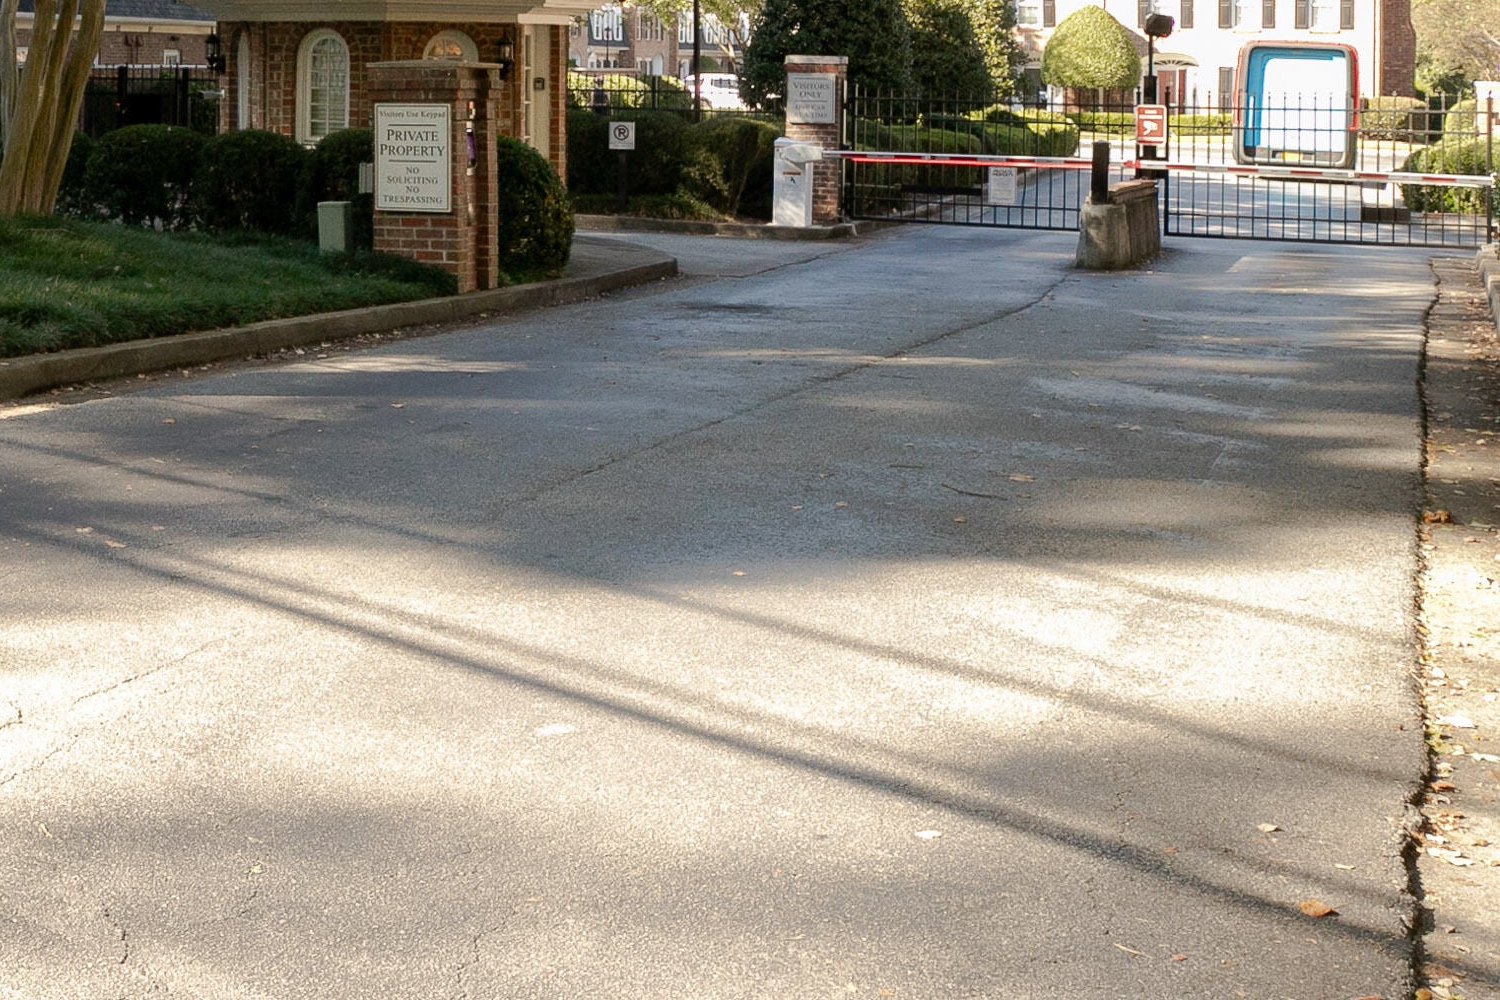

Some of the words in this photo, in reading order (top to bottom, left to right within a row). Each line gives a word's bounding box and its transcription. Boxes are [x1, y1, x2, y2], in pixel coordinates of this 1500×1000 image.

[793, 81, 829, 89] VISITORS
[799, 90, 822, 98] ONLY
[380, 110, 404, 118] Visitors
[420, 111, 445, 119] Keypad
[387, 129, 439, 142] PRIVATE
[380, 143, 445, 157] PROPERTY
[405, 166, 420, 175] NO
[386, 175, 438, 185] SOLICITING
[405, 185, 420, 193] NO
[383, 194, 443, 204] TRESPASSING
